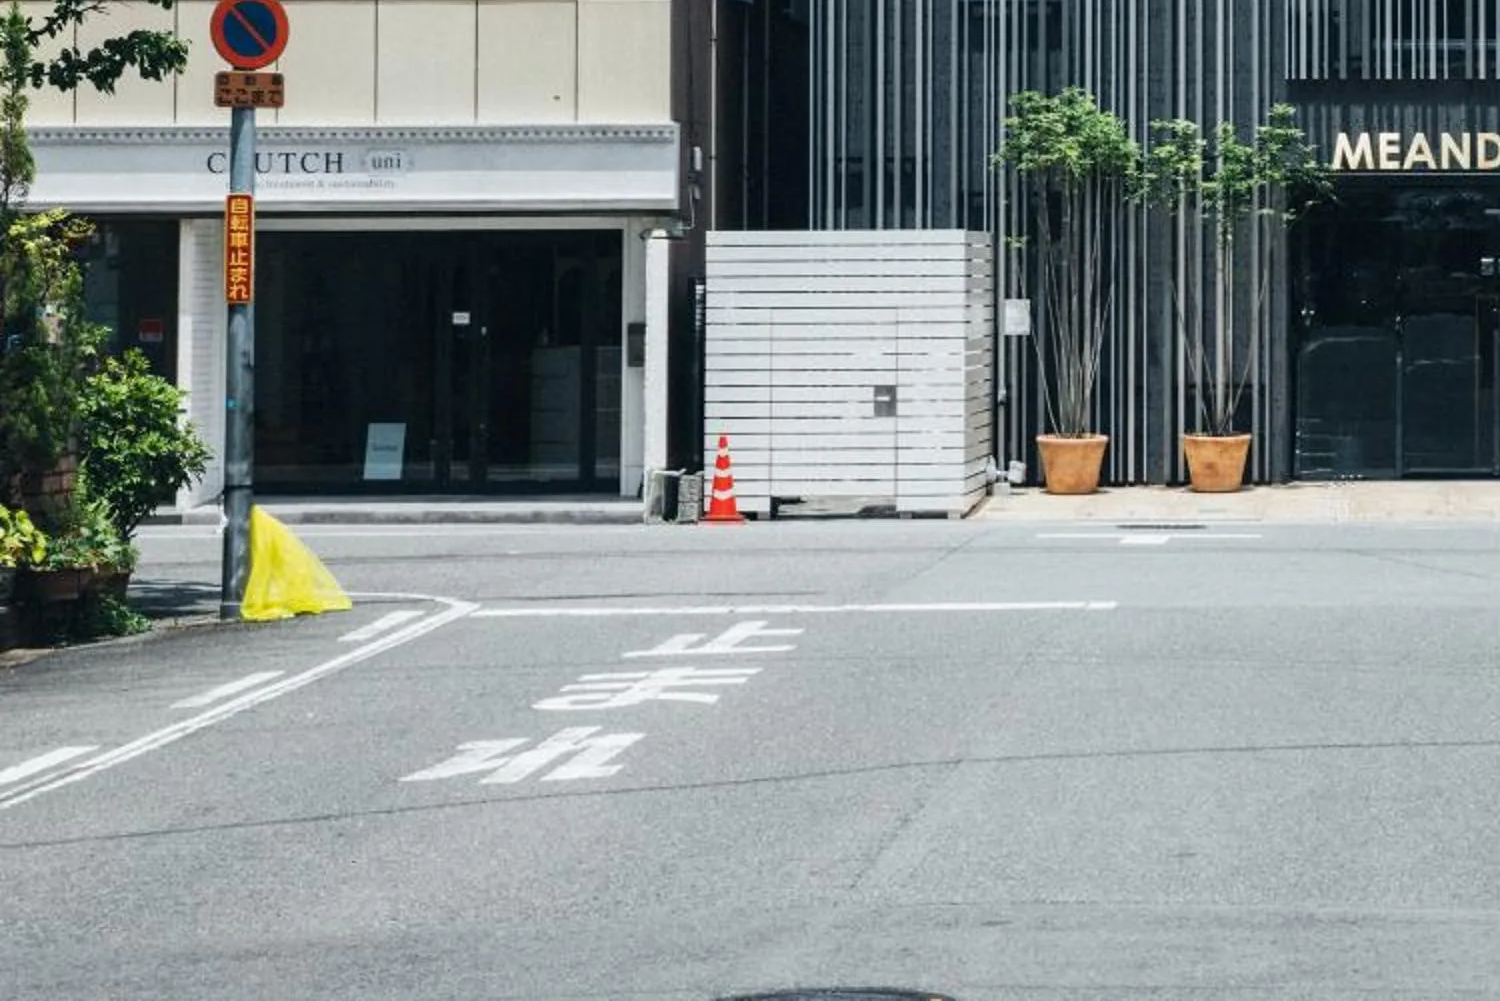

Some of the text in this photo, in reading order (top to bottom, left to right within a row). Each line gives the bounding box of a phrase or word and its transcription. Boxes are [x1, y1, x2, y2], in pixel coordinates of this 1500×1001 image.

[207, 152, 402, 174] CUTCH uni
[229, 198, 249, 301] 自転車止まれ
[398, 620, 805, 785] 止まれ
